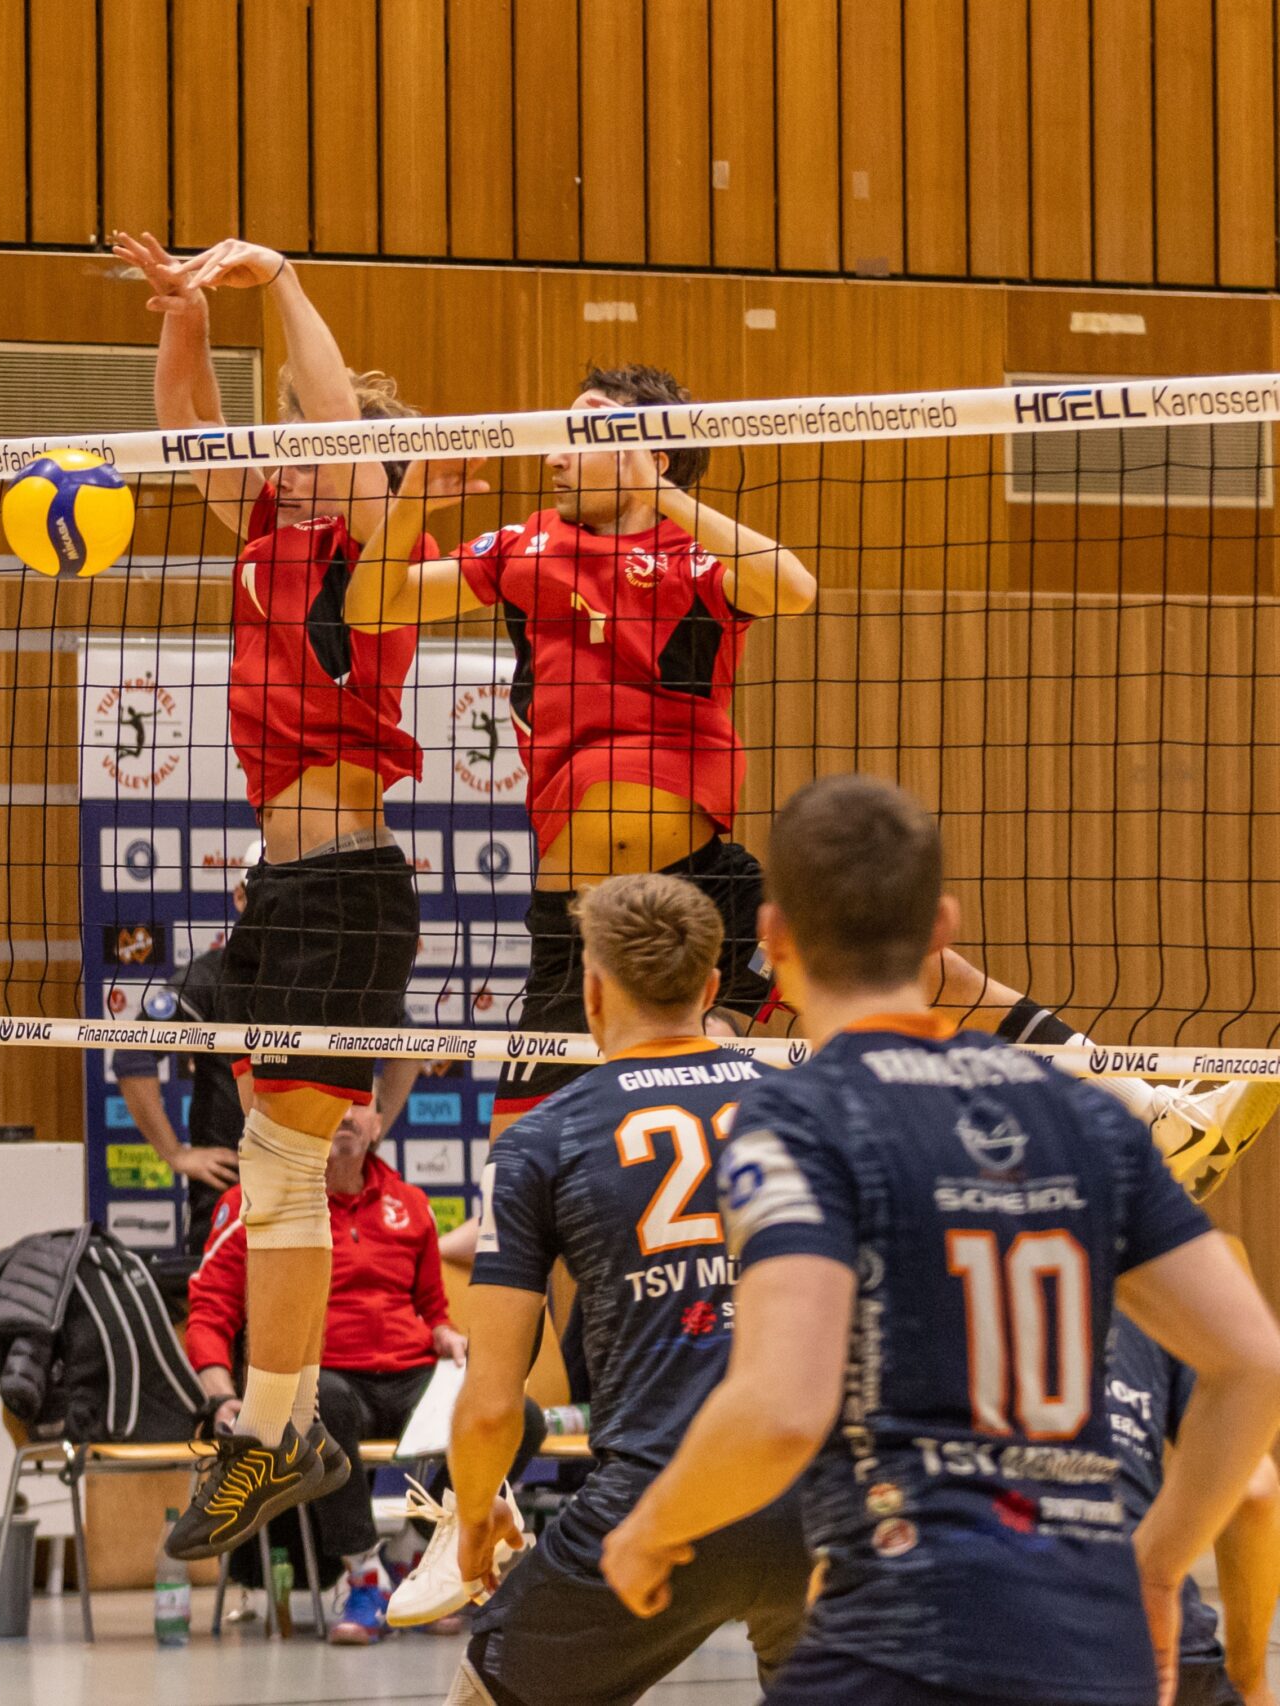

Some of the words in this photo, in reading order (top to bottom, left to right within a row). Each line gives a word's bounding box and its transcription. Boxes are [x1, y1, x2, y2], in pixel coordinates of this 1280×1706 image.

[689, 397, 958, 439] Karosseriefachbetrieb
[273, 419, 515, 459] Karosseriefachbetrieb
[15, 1022, 51, 1040] DVAG
[77, 1024, 148, 1044] Finanzcoach
[150, 1027, 177, 1045] Luca
[179, 1027, 216, 1050] Pilling
[262, 1030, 302, 1049] DVAG
[328, 1032, 404, 1053] Finanzcoach
[406, 1035, 432, 1053] Luca
[434, 1036, 477, 1058] Pilling
[527, 1037, 568, 1057] DVAG
[1111, 1052, 1159, 1072] DVAG
[617, 1060, 762, 1092] GUMENJUK
[625, 1260, 688, 1302] TSV
[945, 1228, 1092, 1440] 10
